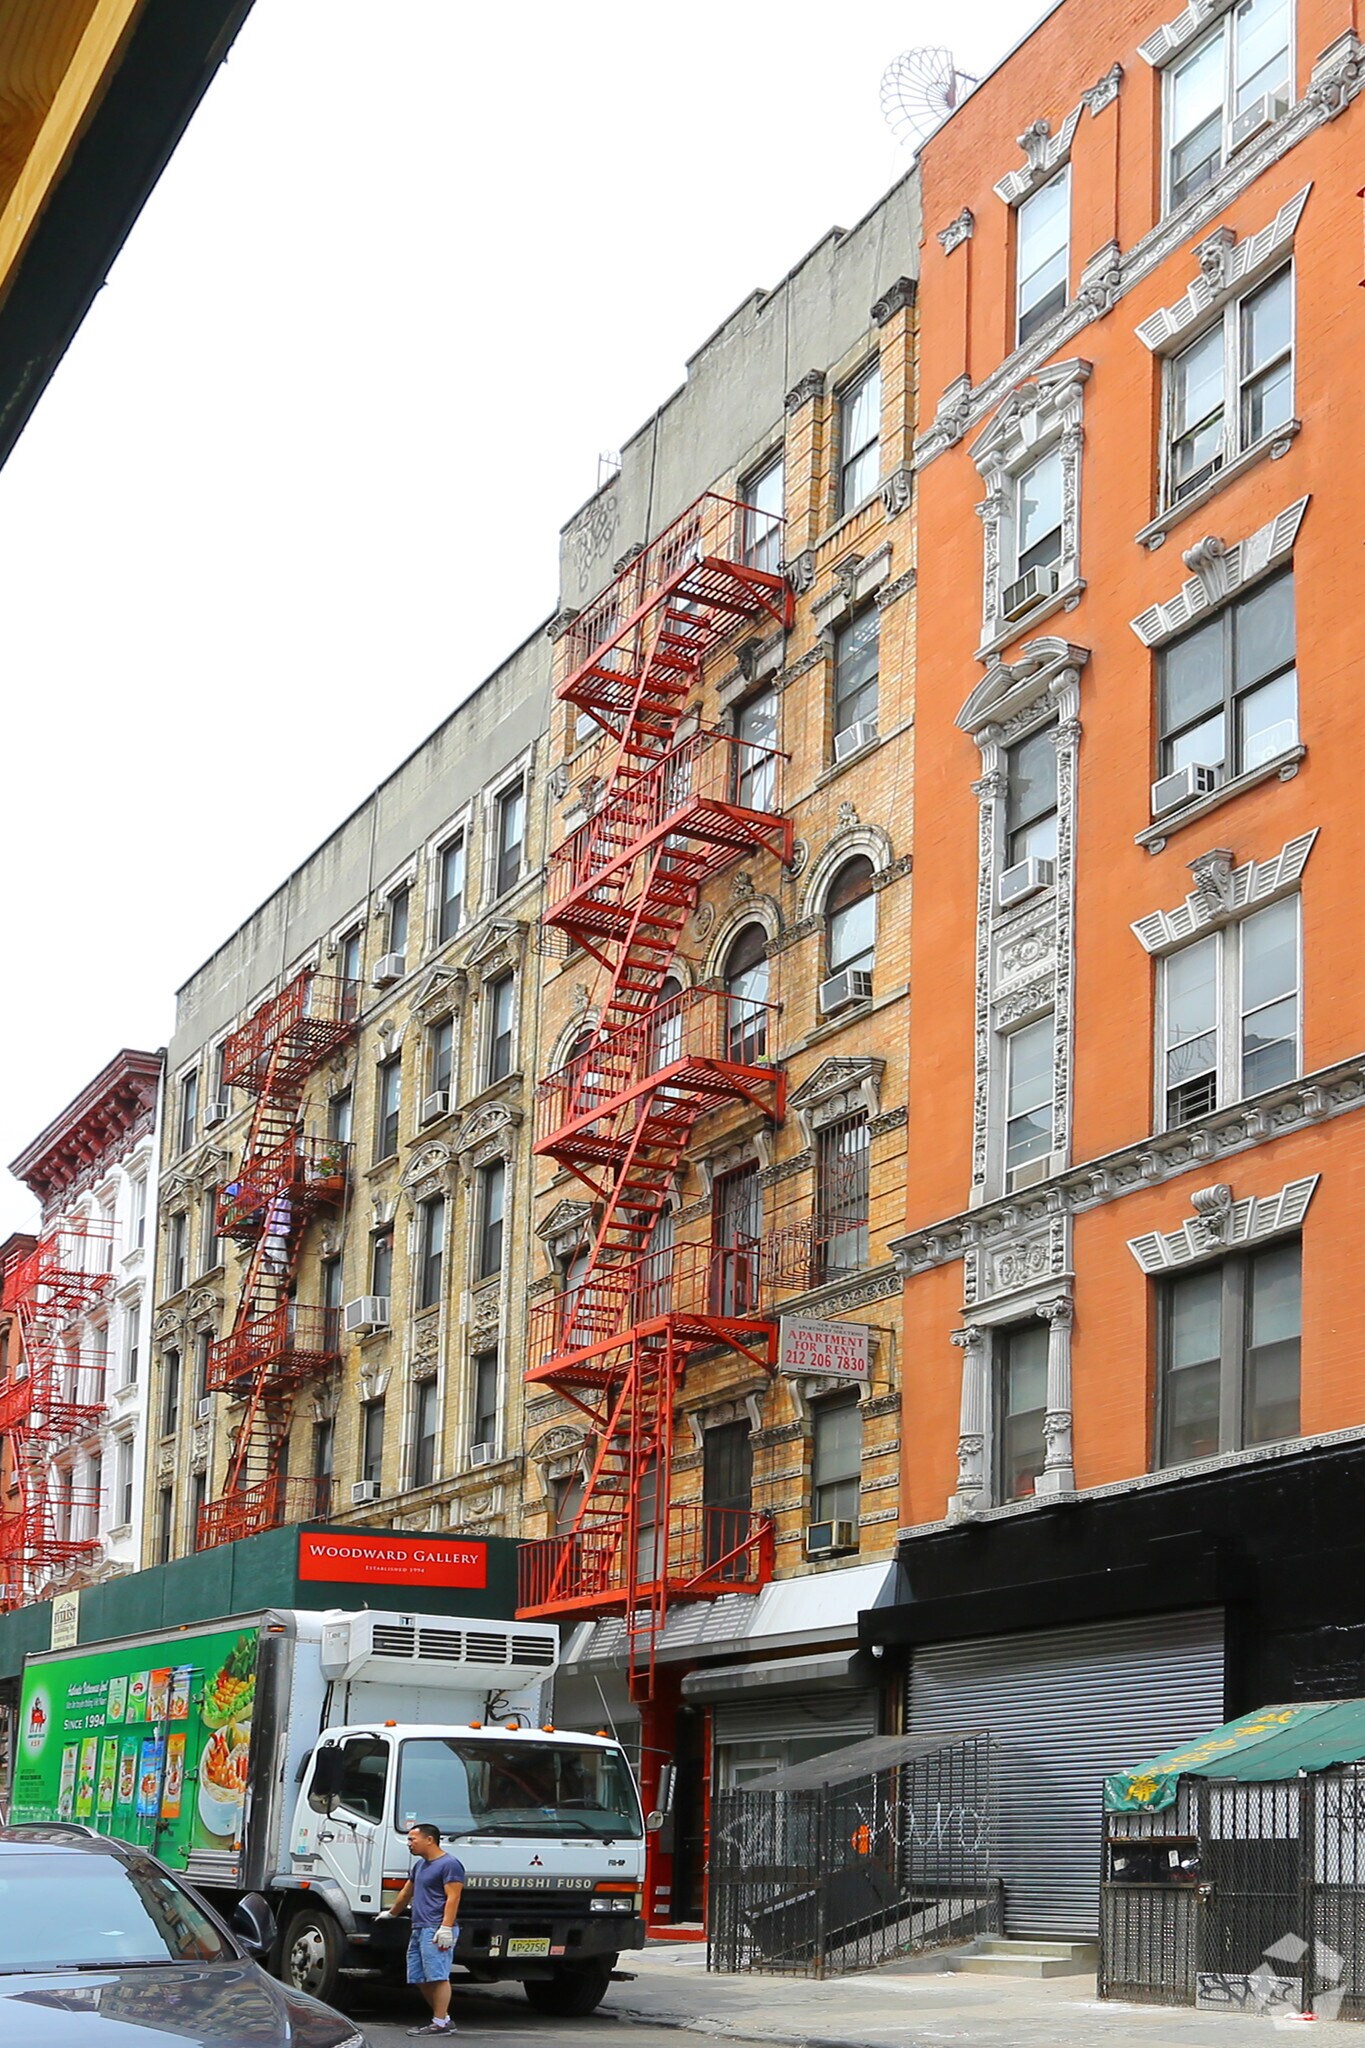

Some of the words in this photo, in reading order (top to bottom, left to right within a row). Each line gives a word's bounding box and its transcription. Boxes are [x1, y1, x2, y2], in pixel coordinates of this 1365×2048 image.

[788, 1330, 864, 1347] APARTMENT
[795, 1341, 818, 1352] FOR
[825, 1344, 856, 1357] RENT
[785, 1350, 806, 1365] 212
[810, 1353, 832, 1368] 206
[837, 1356, 865, 1372] 7830
[309, 1544, 408, 1562] WOODWARD
[413, 1550, 479, 1564] GALLERY
[365, 1565, 408, 1573] ESTABLISHED
[64, 1719, 83, 1731] SINCE
[85, 1713, 105, 1728] 1994
[466, 1877, 551, 1889] MITSUBISHI
[557, 1878, 592, 1889] FUSO
